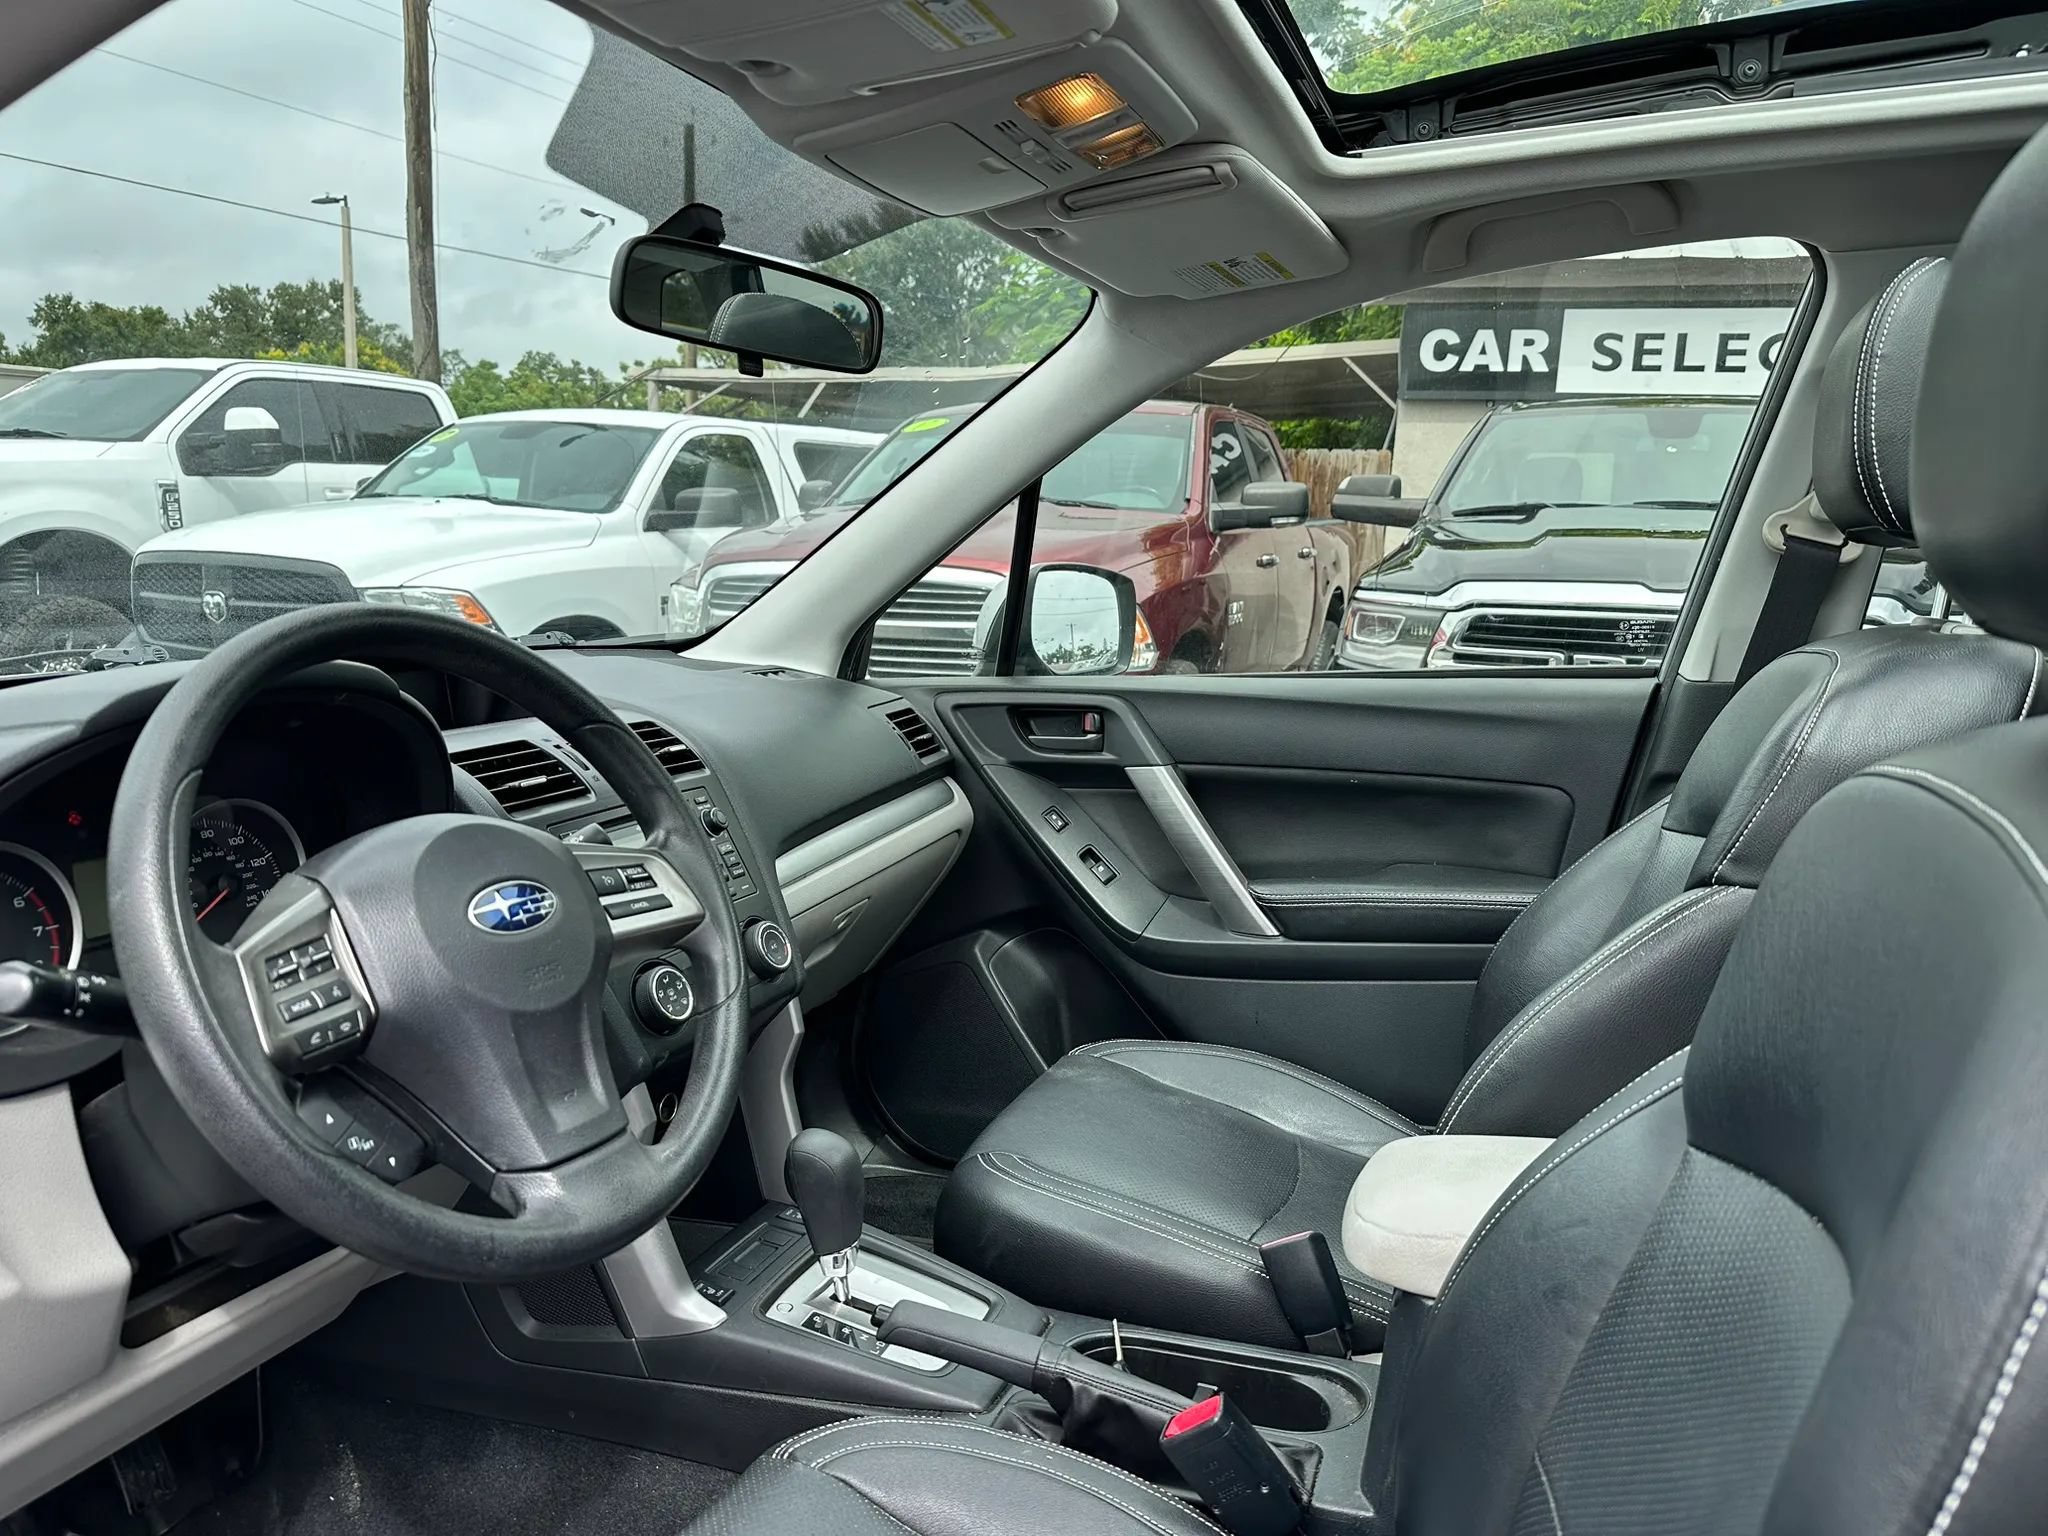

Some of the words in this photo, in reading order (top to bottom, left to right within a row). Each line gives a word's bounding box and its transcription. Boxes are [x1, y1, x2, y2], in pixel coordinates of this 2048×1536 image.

[1419, 328, 1550, 373] CAR
[200, 829, 214, 838] 80
[228, 836, 244, 846] 100
[250, 858, 266, 867] 120
[13, 896, 26, 908] 6
[32, 925, 44, 937] 7
